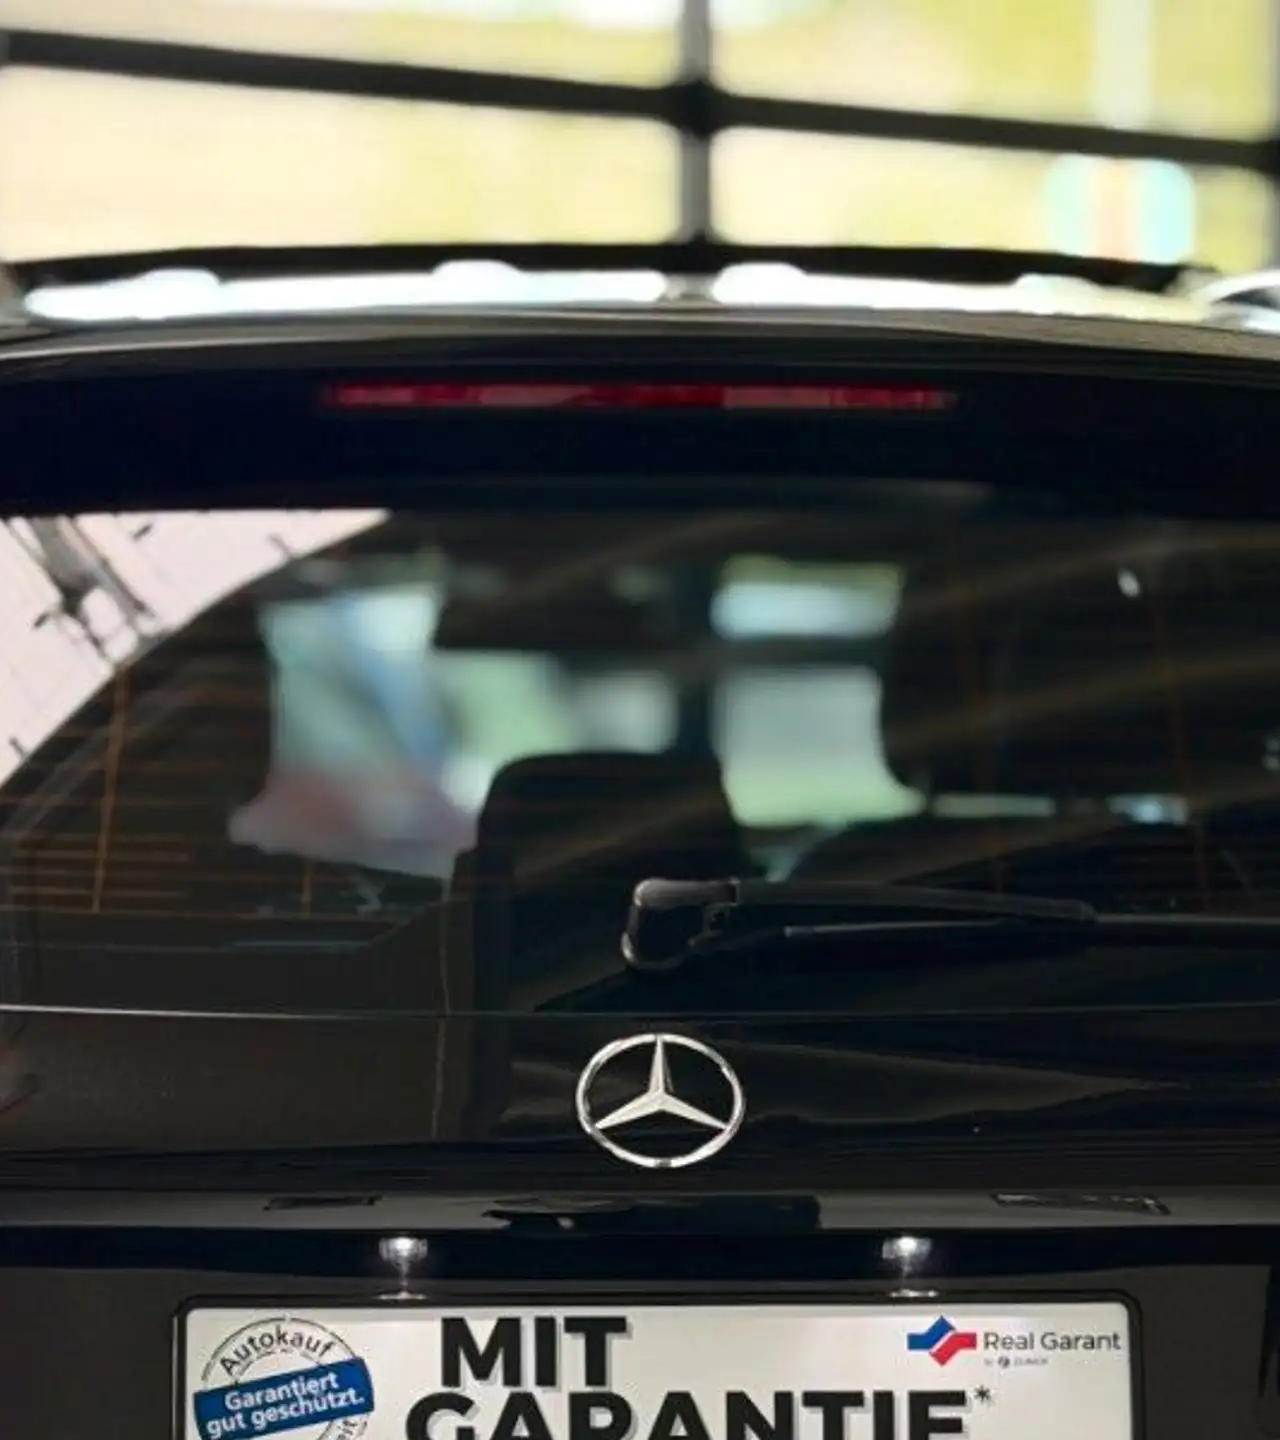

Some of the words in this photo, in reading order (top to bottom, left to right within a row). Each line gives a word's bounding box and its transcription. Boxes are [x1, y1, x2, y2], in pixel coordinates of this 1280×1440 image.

[218, 1325, 337, 1377] Autokauf
[440, 1316, 627, 1387] MIT
[982, 1332, 1035, 1351] Real
[1039, 1332, 1122, 1351] Garant
[206, 1411, 246, 1440] gut
[251, 1386, 365, 1431] geschützt.
[224, 1371, 340, 1412] Garantiert
